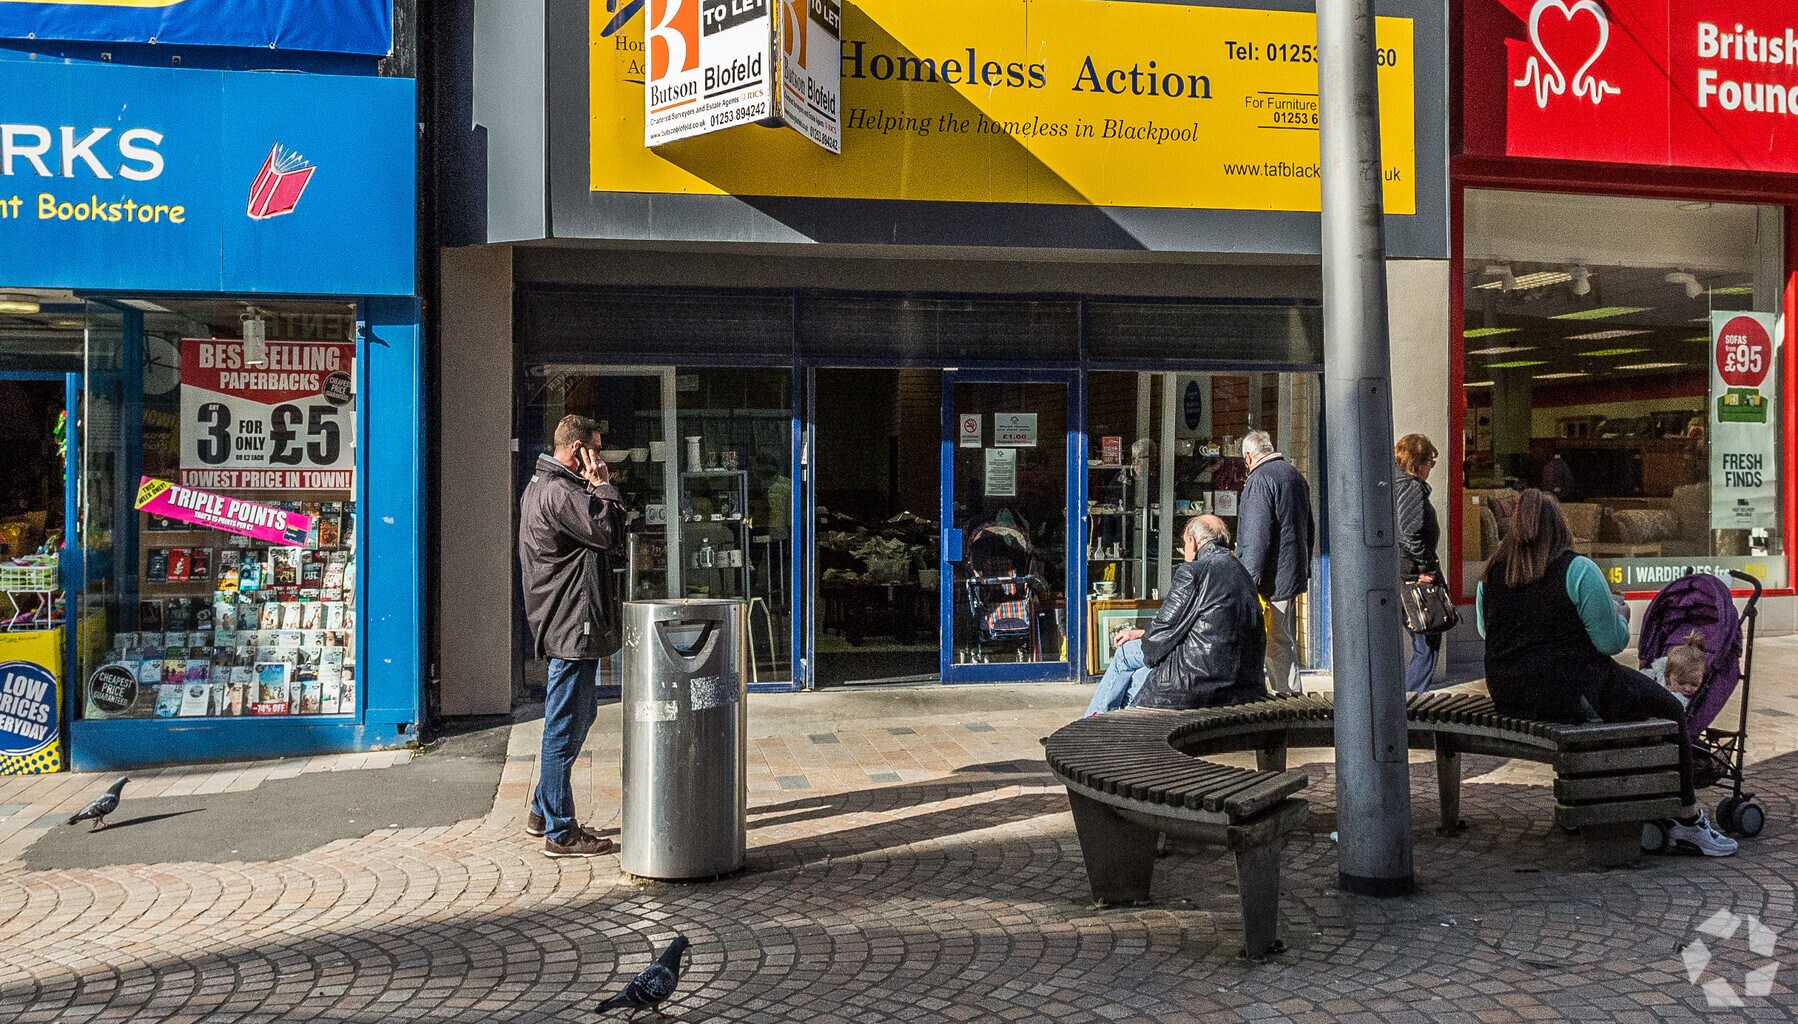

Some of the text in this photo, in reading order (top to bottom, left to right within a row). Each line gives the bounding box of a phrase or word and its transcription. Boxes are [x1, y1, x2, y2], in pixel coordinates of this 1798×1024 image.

[704, 5, 727, 25] TO
[824, 6, 839, 29] LET
[1225, 41, 1259, 61] Tel:
[651, 52, 761, 107] Butson Blofeld
[840, 40, 1213, 99] Homeless Action
[808, 76, 836, 115] Blofeld
[1245, 96, 1317, 111] For Furniture
[672, 109, 695, 120] Surveyors
[722, 97, 739, 108] Agents
[711, 111, 733, 127] 01253
[736, 102, 765, 121] 894242
[1273, 112, 1308, 125] 01253
[848, 108, 932, 137] Helping
[938, 113, 969, 133] the
[977, 114, 1068, 138] homeless
[1075, 117, 1095, 137] in
[1102, 118, 1199, 145] Blackpool
[38, 192, 186, 224] Bookstore
[1725, 334, 1748, 345] SOFAS
[1724, 344, 1763, 373] £95
[219, 371, 320, 391] PAPERBACKS
[209, 403, 220, 411] ANY
[197, 402, 340, 466] 3 £5
[238, 420, 263, 435] FOR
[235, 436, 266, 451] ONLY
[1722, 453, 1763, 470] FRESH
[142, 482, 156, 494] THIS
[182, 470, 350, 489] LOWEST PRICE IN TOWN!
[1725, 471, 1763, 488] FINDS
[168, 485, 225, 517] TRIPLE
[227, 499, 287, 531] POINTS
[3, 672, 49, 703] LOW
[99, 672, 133, 689] CHEAPEST
[101, 682, 125, 698] PRICE
[93, 690, 129, 707] GUARANTEED
